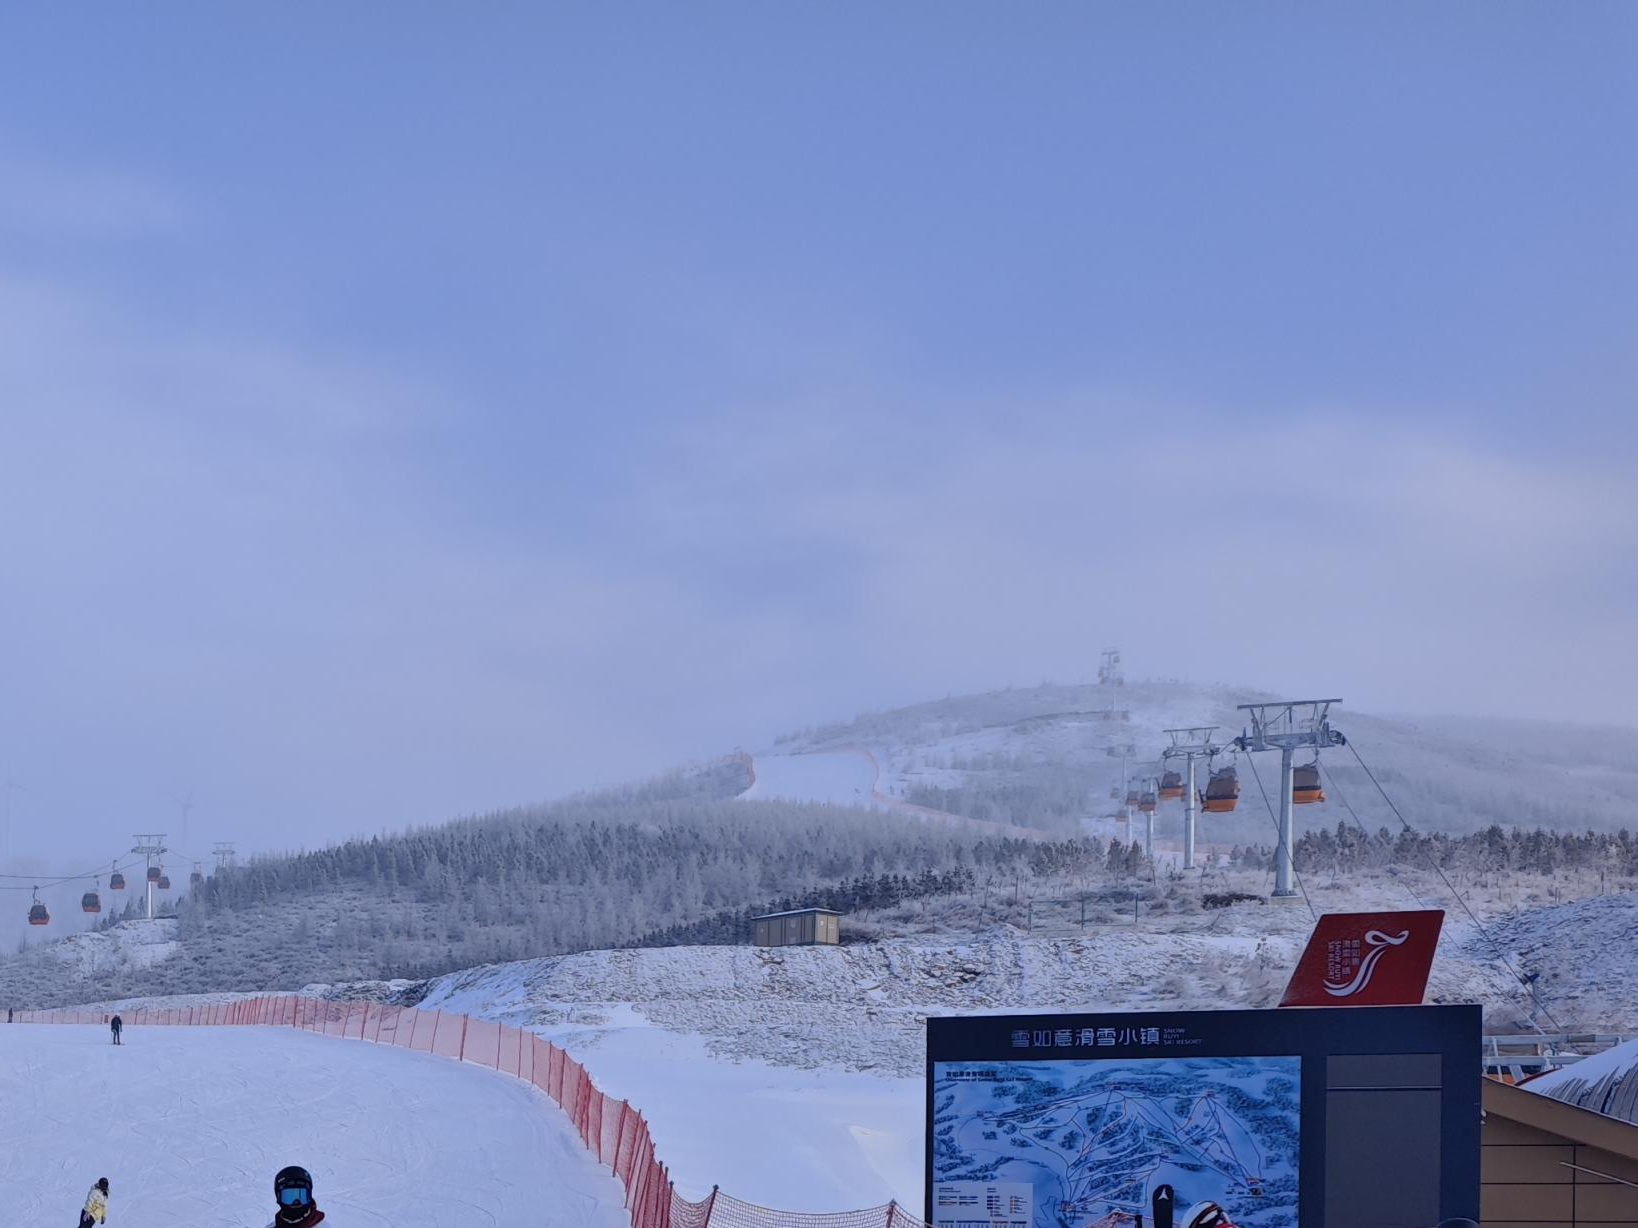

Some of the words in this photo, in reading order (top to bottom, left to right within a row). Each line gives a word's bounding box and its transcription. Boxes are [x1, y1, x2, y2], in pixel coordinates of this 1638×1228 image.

[1010, 1027, 1161, 1049] 雪如意滑雪小镇
